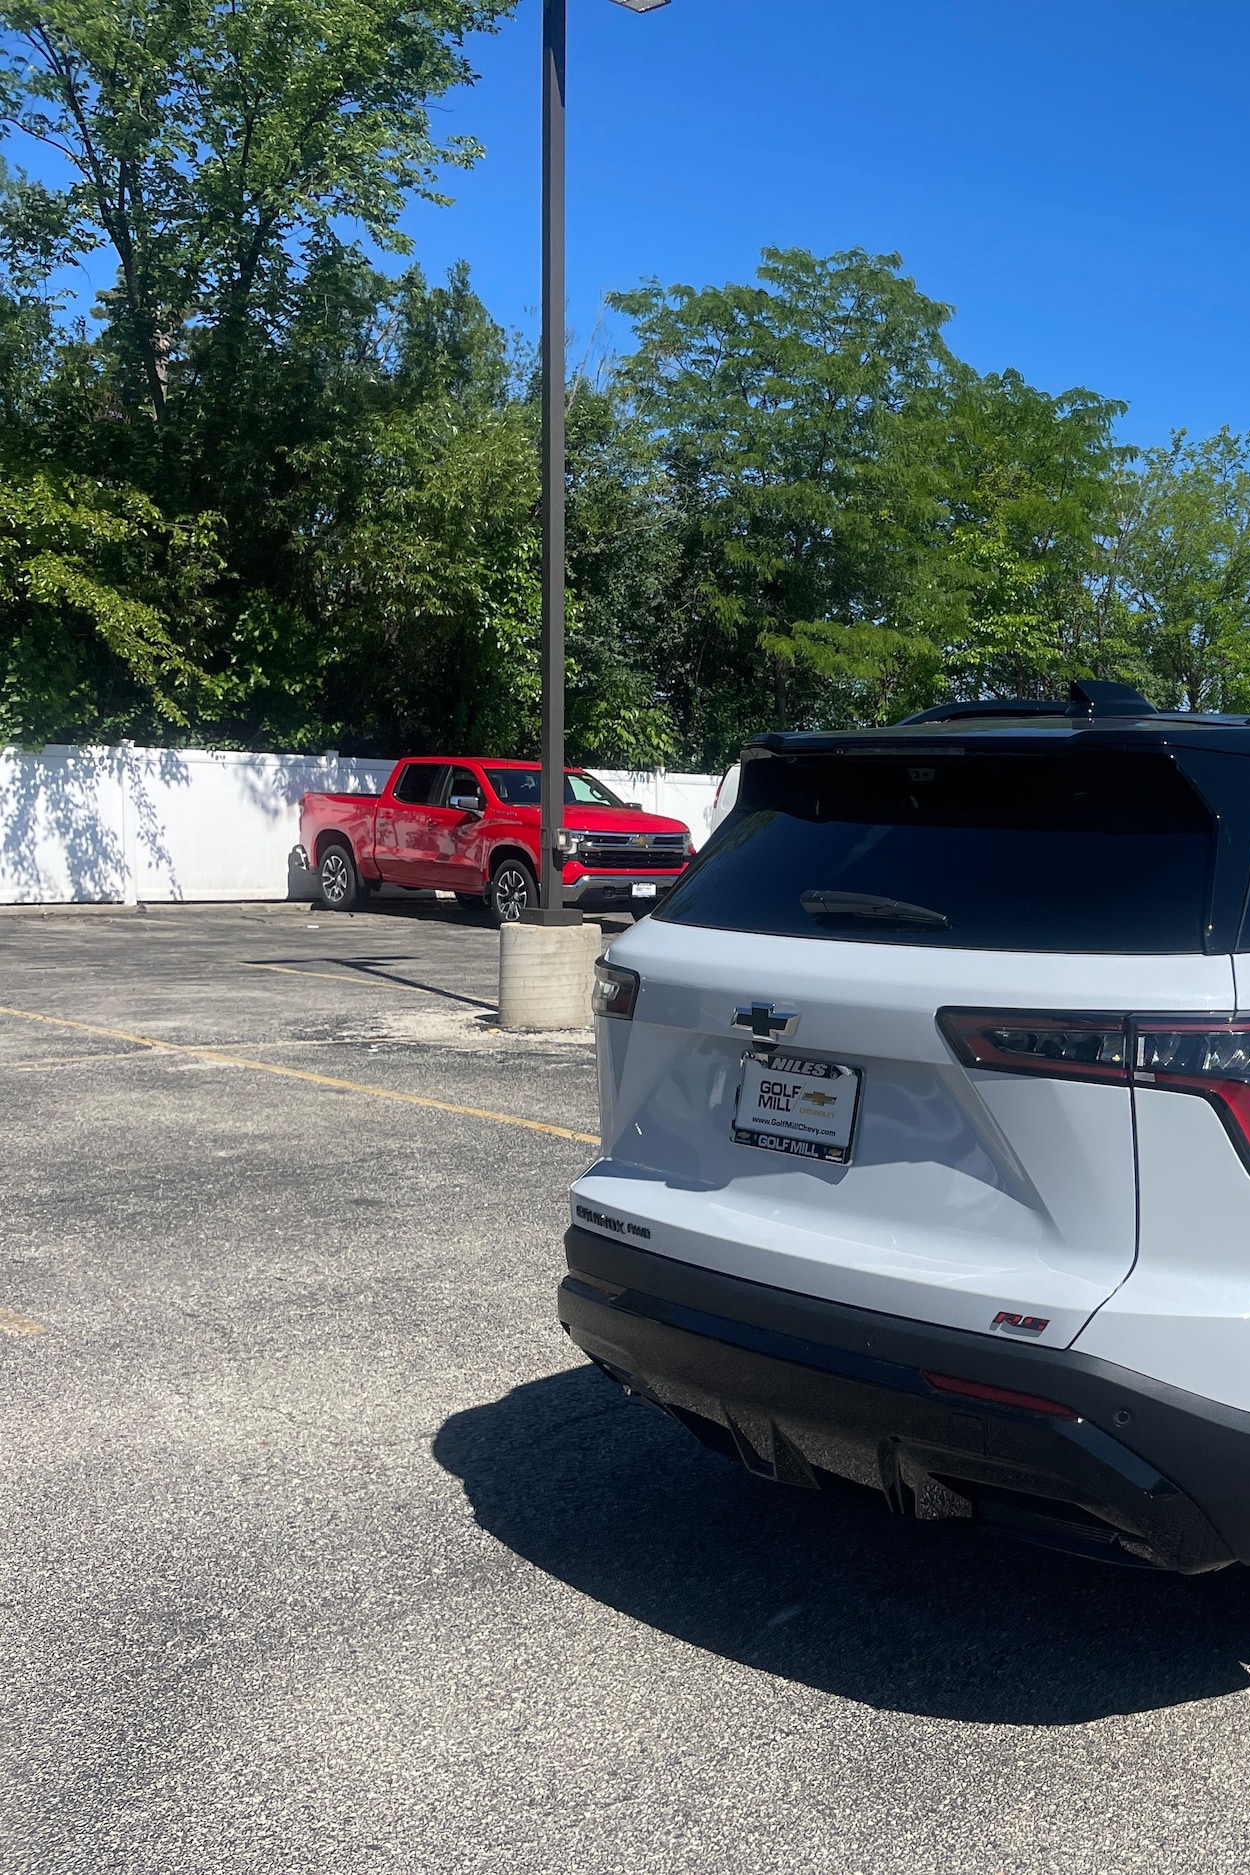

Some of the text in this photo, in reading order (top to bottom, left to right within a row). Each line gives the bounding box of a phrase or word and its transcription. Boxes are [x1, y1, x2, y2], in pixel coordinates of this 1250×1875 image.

[771, 1057, 828, 1077] NILES
[760, 1080, 802, 1099] GOLF
[758, 1094, 791, 1112] MILL
[752, 1115, 836, 1137] www.GolfMillChevy.com
[758, 1134, 818, 1158] GOLF MILL
[991, 1311, 1051, 1333] RS
